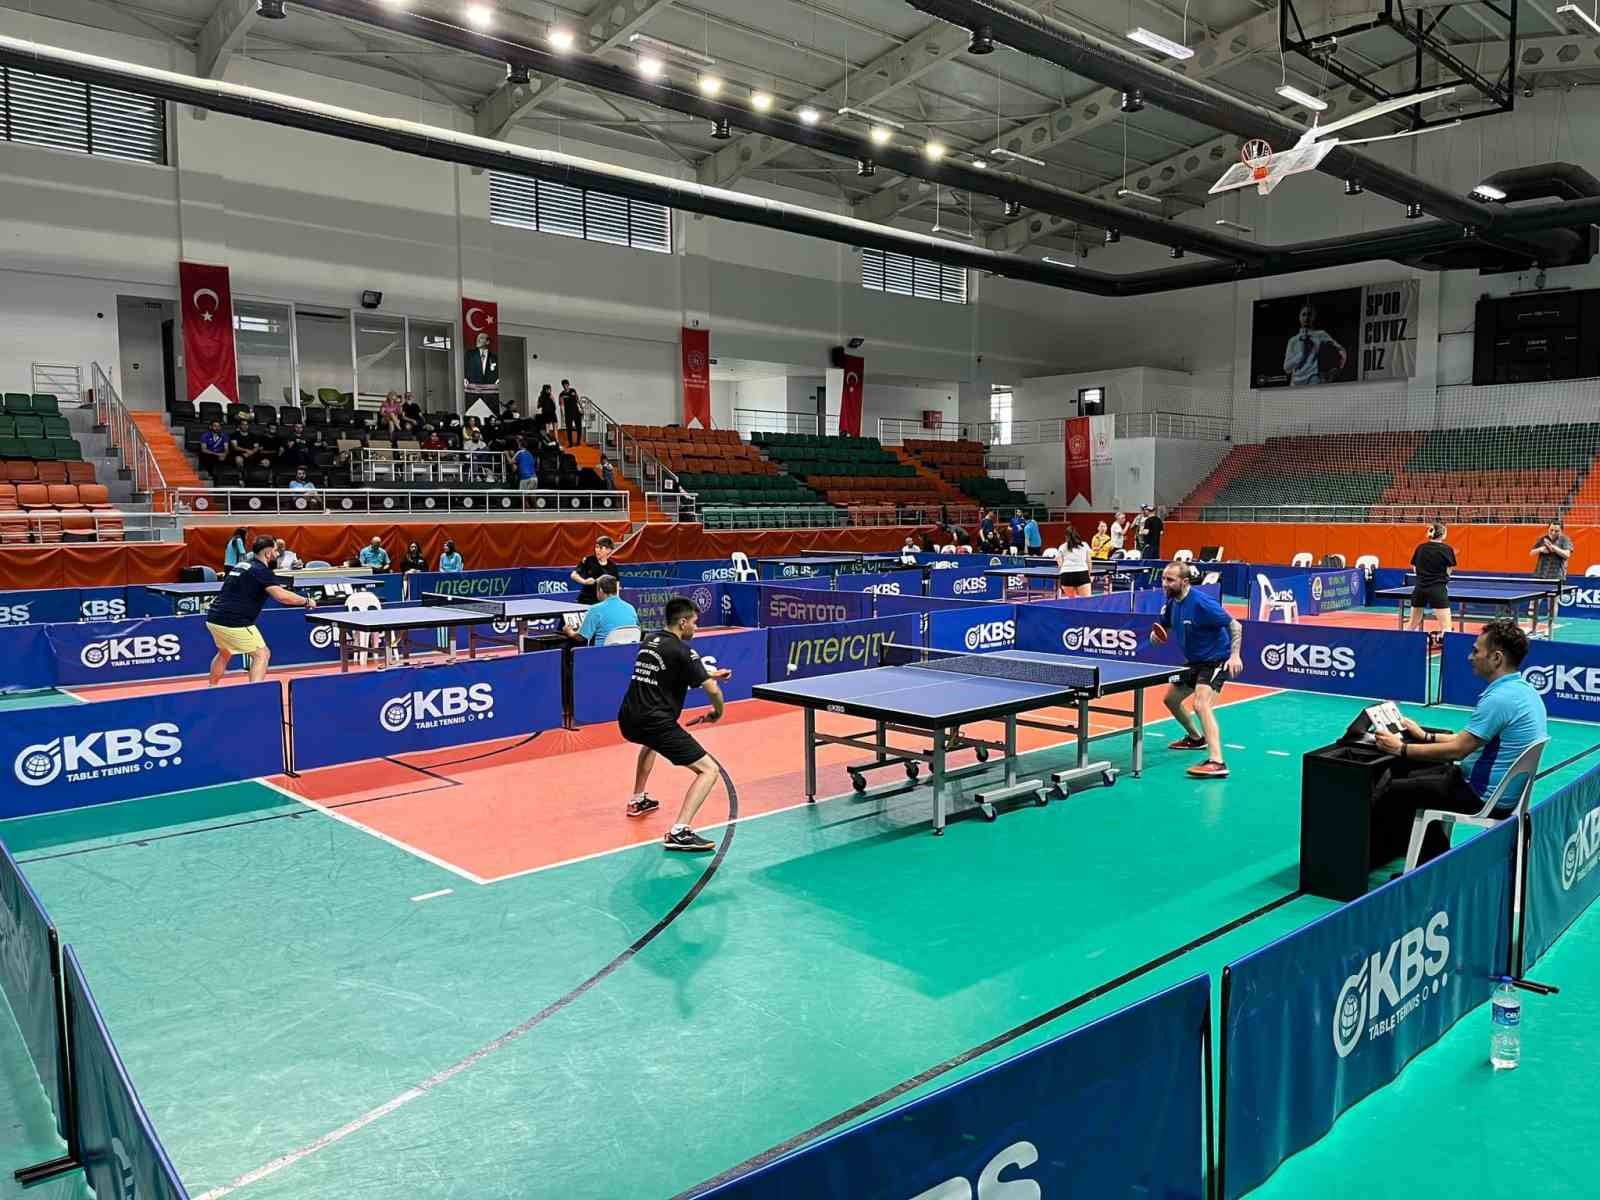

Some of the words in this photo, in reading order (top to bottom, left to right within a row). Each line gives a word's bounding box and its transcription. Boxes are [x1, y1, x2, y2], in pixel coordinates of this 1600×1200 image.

[1366, 291, 1400, 317] SPOR
[711, 567, 736, 580] KBS
[962, 576, 987, 590] KBS
[1008, 574, 1024, 587] BS
[546, 580, 569, 592] KBS
[873, 582, 900, 596] KBS
[980, 620, 1015, 643] KBS
[1083, 627, 1138, 651] KBS
[110, 634, 180, 660] KBS
[1286, 643, 1356, 671] KBS
[1556, 665, 1600, 693] KB
[413, 682, 494, 720] KBS
[416, 720, 439, 729] TABLE
[439, 716, 466, 726] TENNIS
[63, 722, 182, 771] KBS
[67, 771, 100, 783] TABLE
[101, 764, 141, 778] TENNIS
[1369, 911, 1450, 1020] KBS
[1368, 1015, 1396, 1042] TABLE
[1395, 993, 1421, 1024] TENNIS
